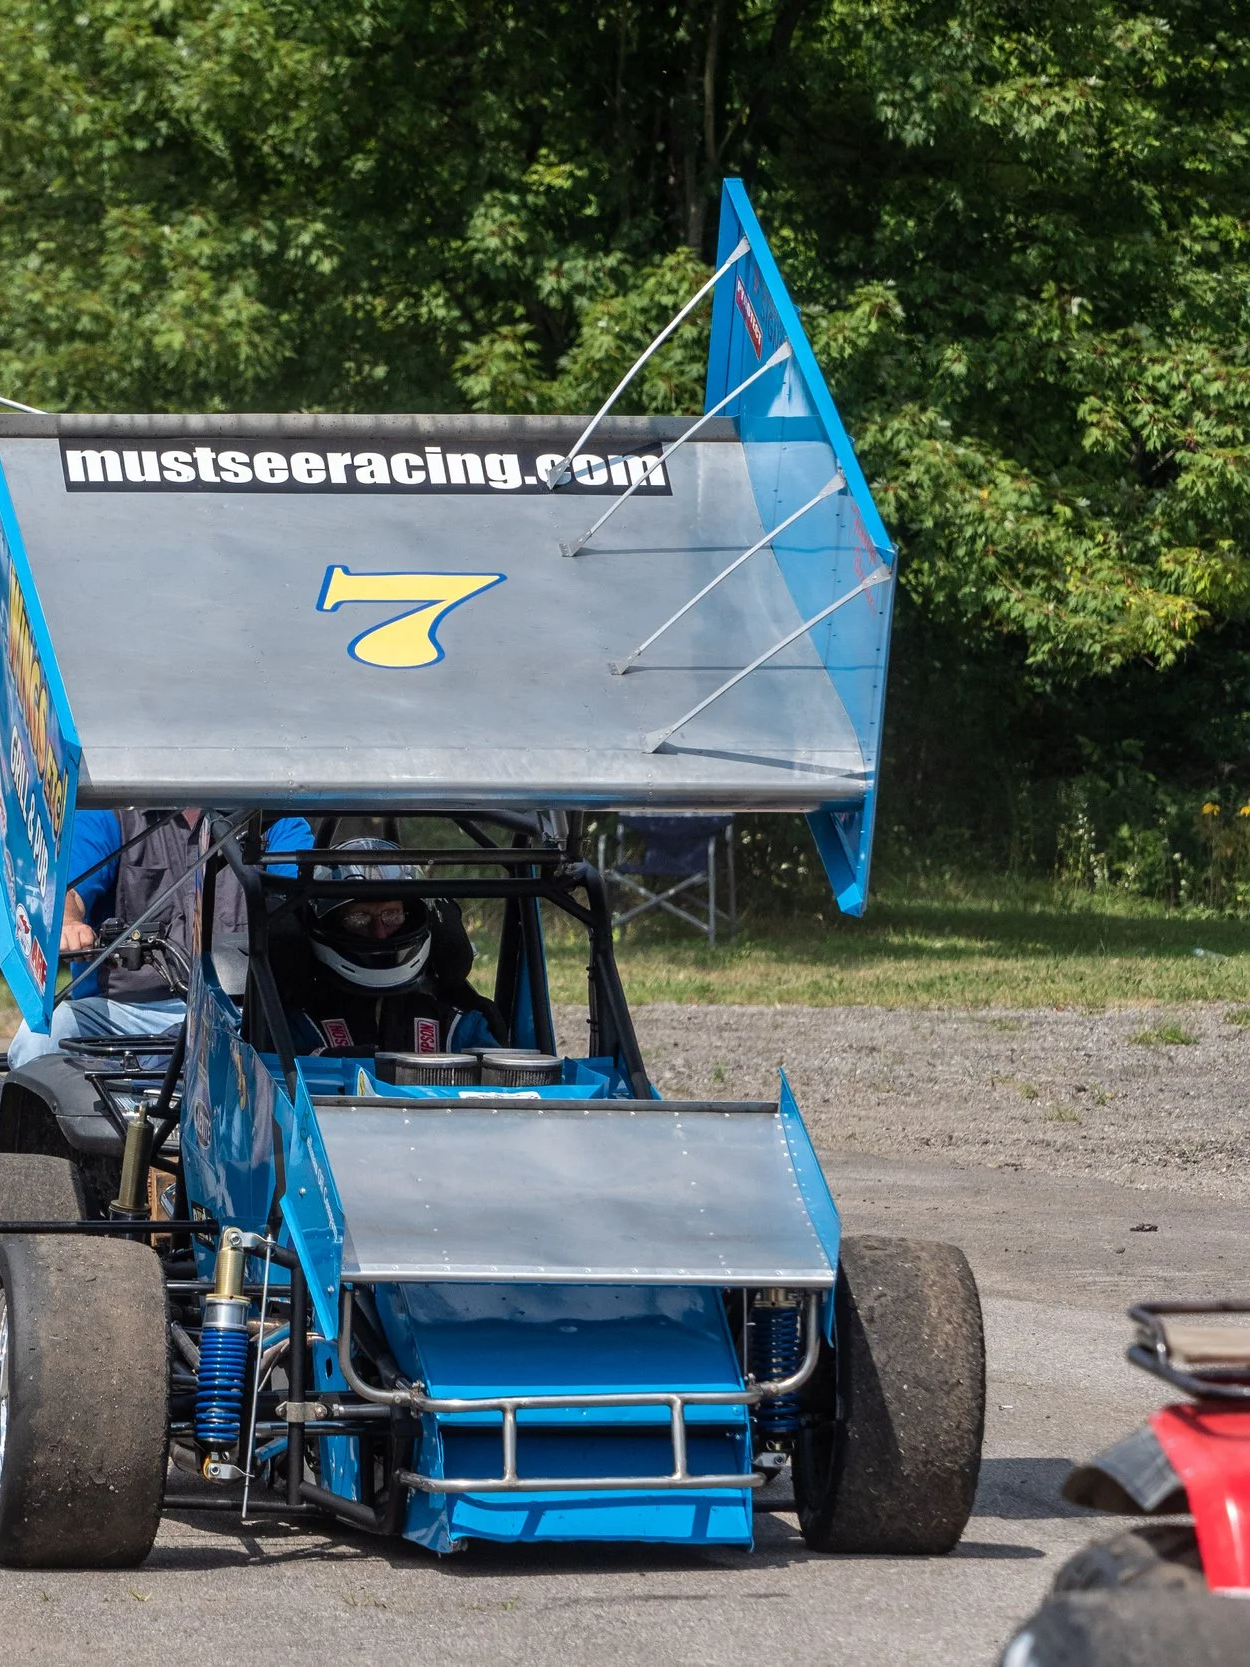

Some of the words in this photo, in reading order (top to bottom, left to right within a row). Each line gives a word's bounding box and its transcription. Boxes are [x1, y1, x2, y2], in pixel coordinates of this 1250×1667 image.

[66, 446, 667, 490] mustseeracing.com
[316, 564, 507, 669] 7
[11, 723, 28, 822] GRILL
[27, 792, 36, 847] &
[34, 814, 49, 899] PUB
